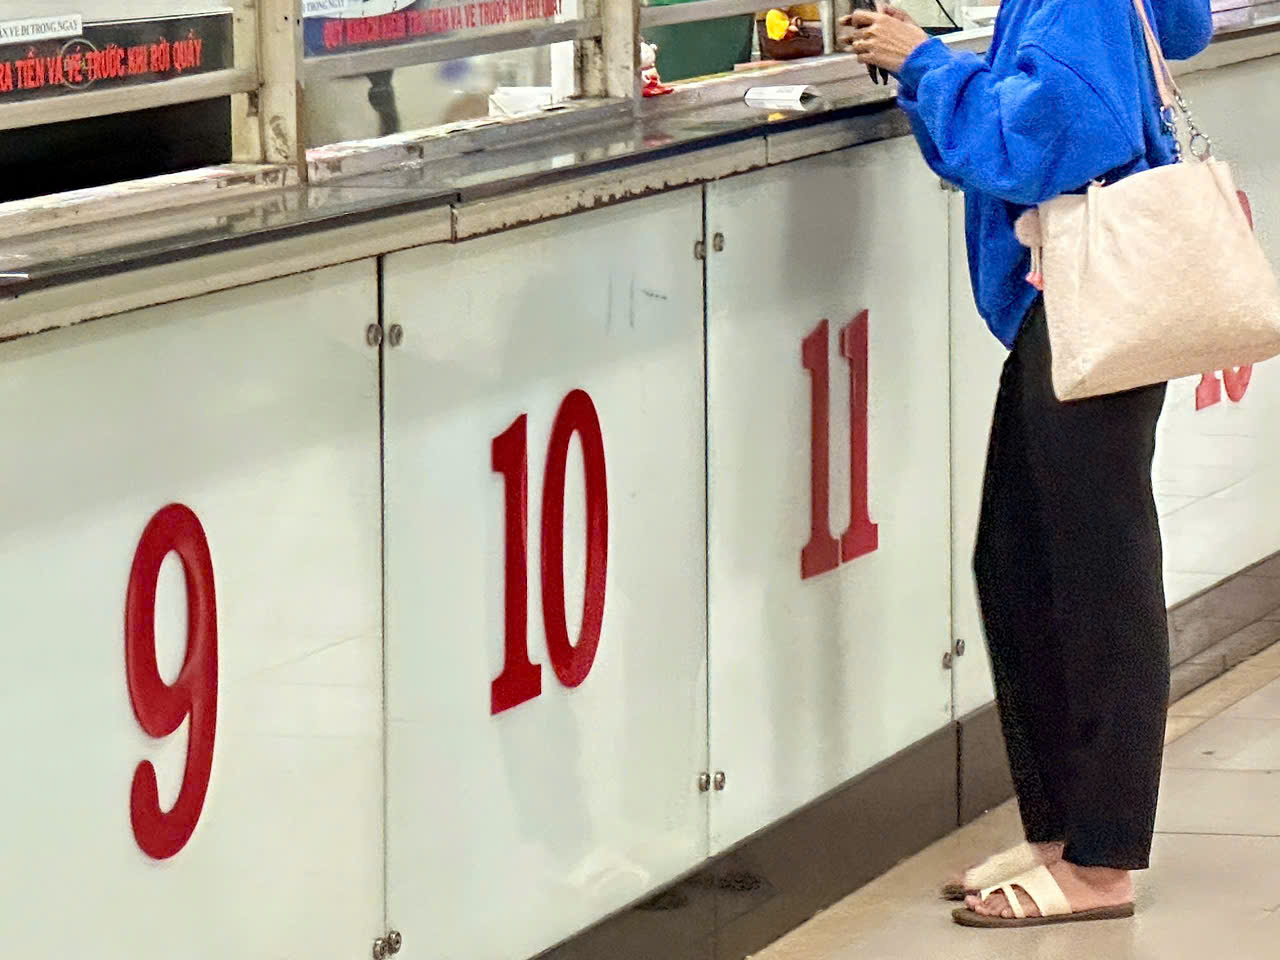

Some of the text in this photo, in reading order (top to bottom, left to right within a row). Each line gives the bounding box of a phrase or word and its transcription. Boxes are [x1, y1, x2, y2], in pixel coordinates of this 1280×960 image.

[490, 388, 608, 716] 10
[801, 309, 879, 580] 11
[126, 503, 219, 860] 9
